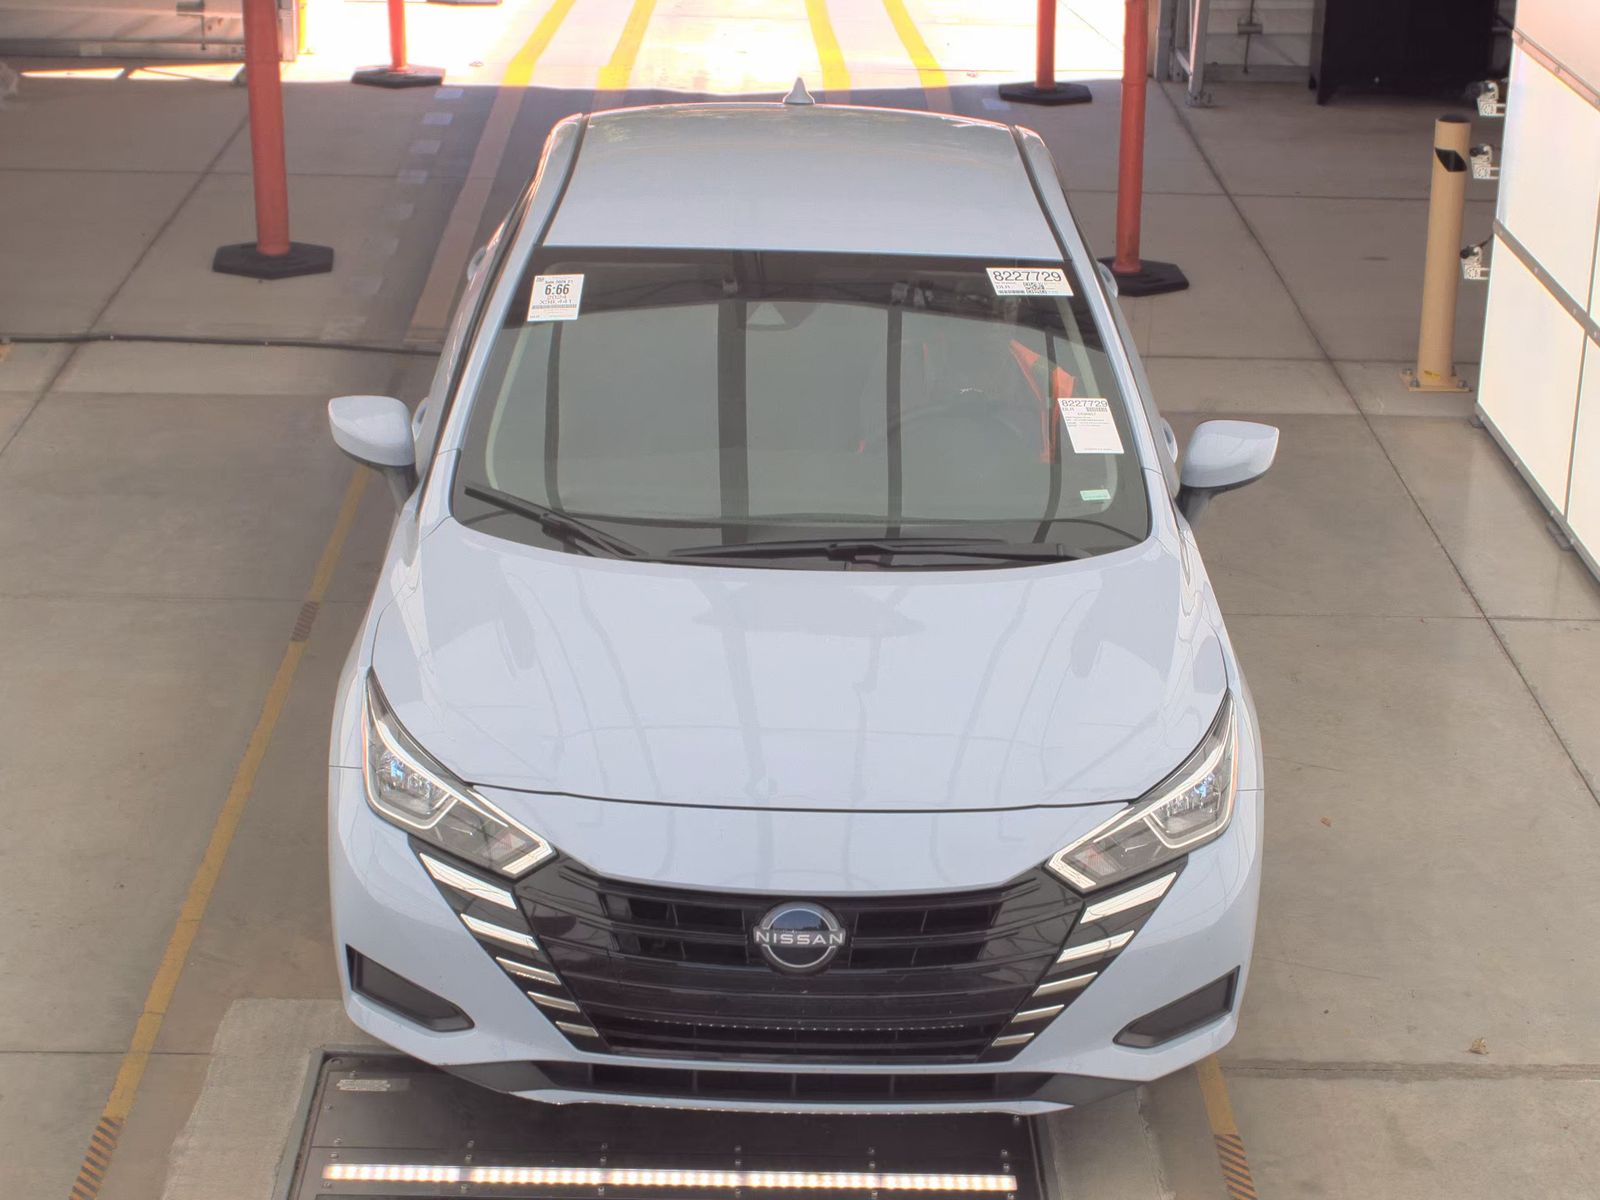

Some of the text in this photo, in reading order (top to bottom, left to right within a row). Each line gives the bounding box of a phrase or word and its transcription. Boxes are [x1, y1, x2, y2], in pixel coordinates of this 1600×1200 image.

[992, 270, 1062, 282] 8227729
[544, 283, 570, 295] 6:66
[1061, 399, 1108, 408] 8227729
[755, 930, 843, 945] NISSAN
